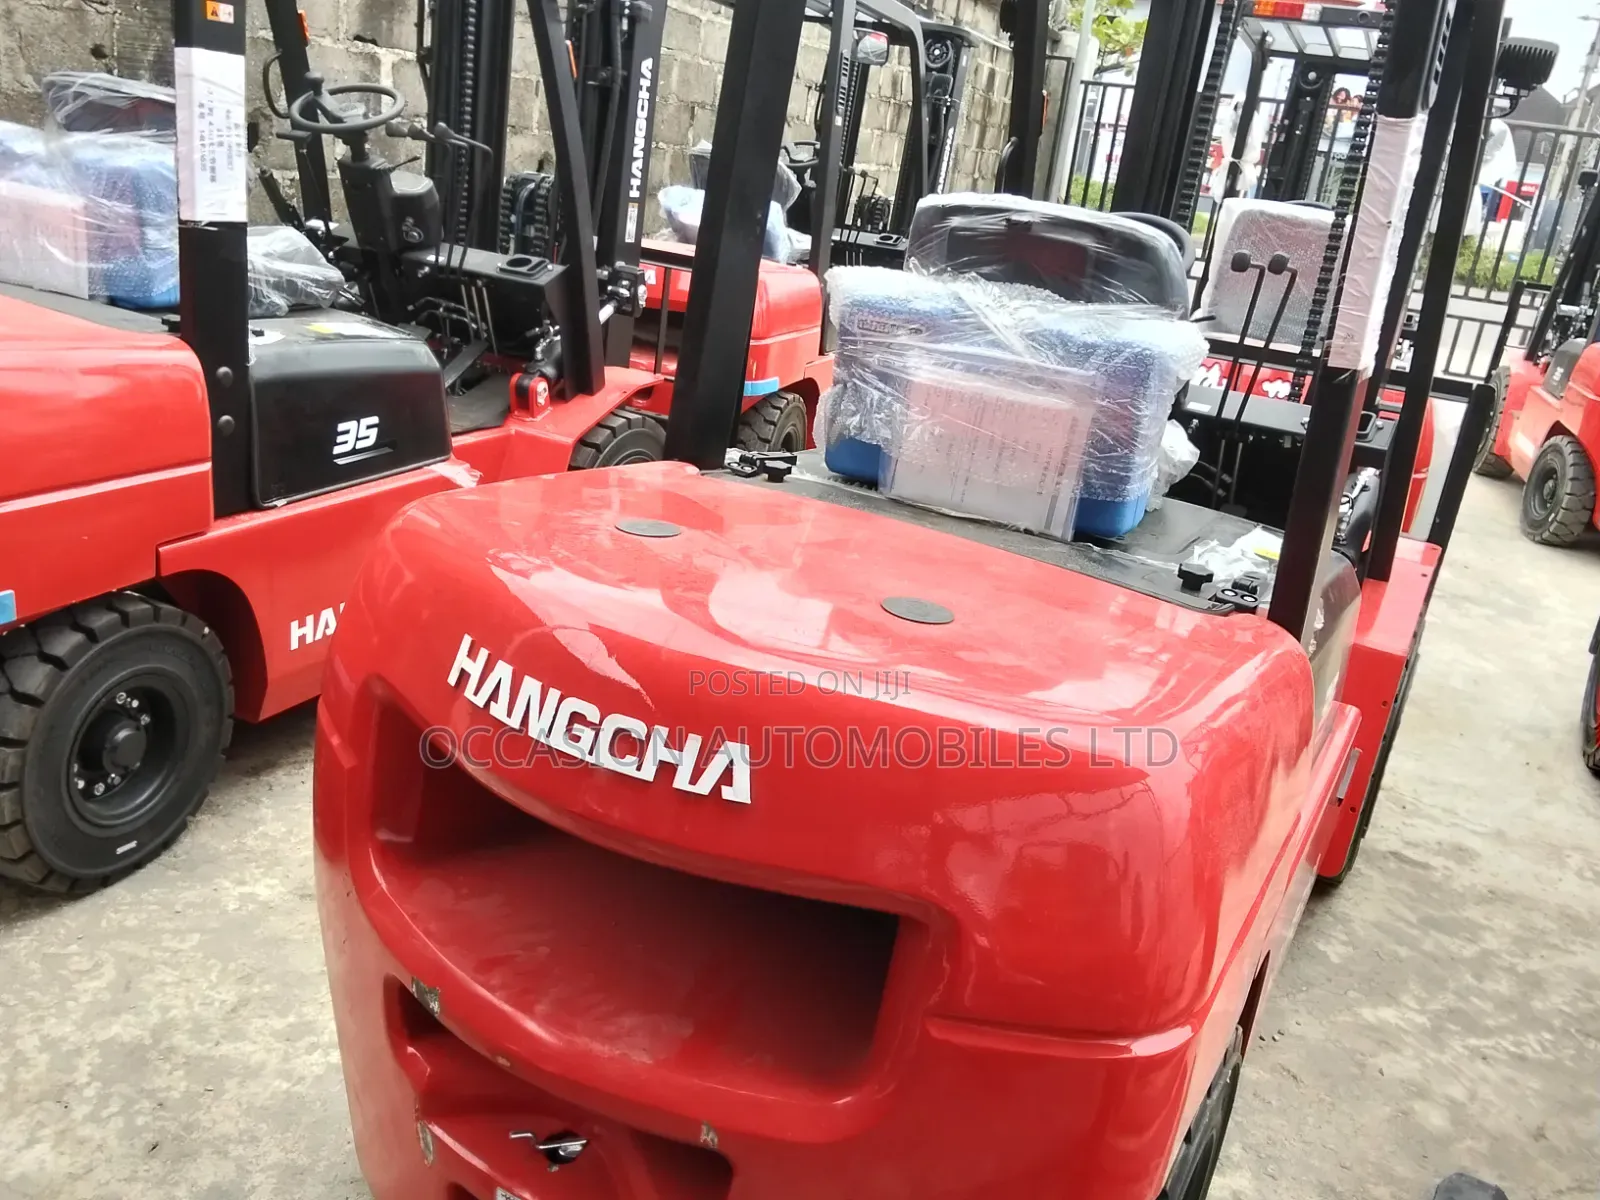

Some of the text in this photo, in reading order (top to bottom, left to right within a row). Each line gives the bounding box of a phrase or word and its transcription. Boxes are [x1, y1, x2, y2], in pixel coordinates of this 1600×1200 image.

[629, 57, 653, 198] HANGCHA
[937, 126, 954, 195] ANGCHA
[332, 416, 379, 455] 35
[447, 633, 752, 804] HANGCHA
